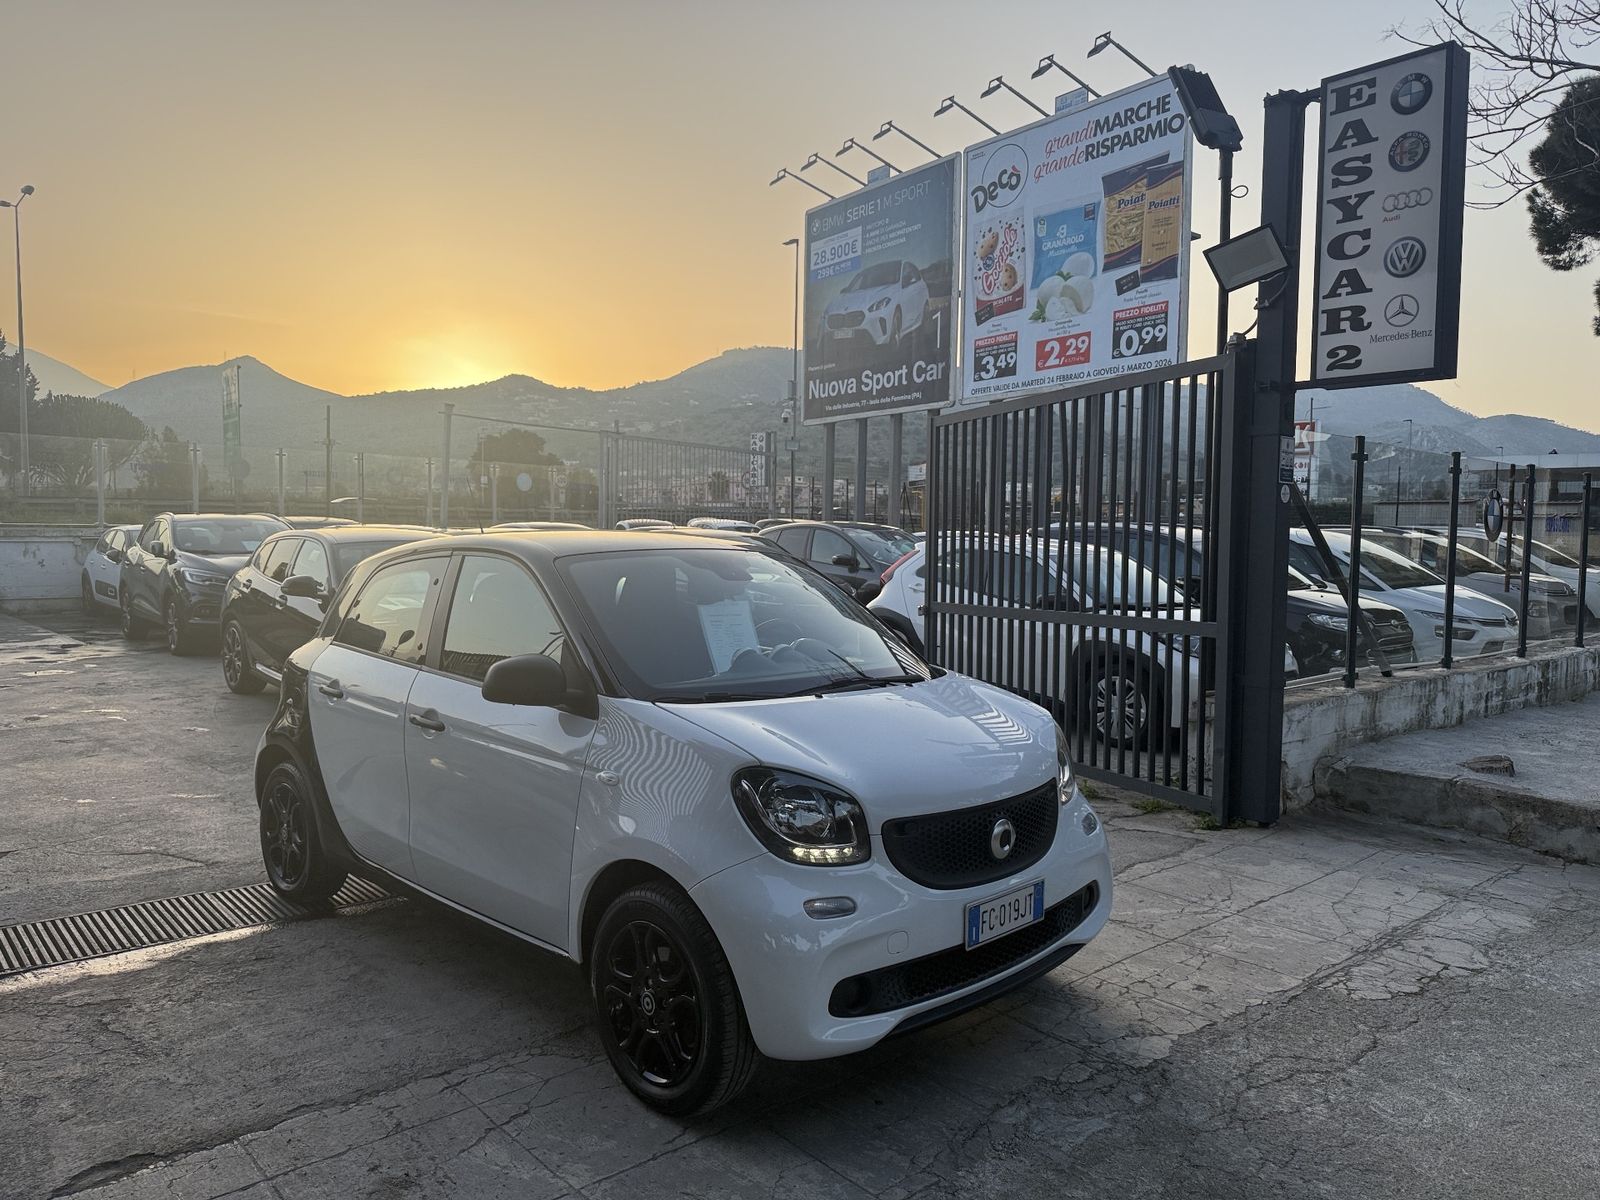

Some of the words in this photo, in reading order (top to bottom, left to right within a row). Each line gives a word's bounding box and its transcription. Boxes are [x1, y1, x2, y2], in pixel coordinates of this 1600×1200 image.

[822, 212, 845, 231] BMW
[847, 201, 874, 222] SERIE
[876, 198, 881, 215] 1
[883, 194, 892, 209] M
[894, 179, 931, 206] SPORT
[1148, 196, 1180, 210] Poiatti
[1382, 214, 1401, 223] Audi
[1042, 234, 1085, 251] GRANAROLO
[813, 240, 858, 266] 28.900€
[1115, 309, 1140, 319] PREZZO
[1141, 303, 1166, 314] FIDELITY
[1369, 328, 1433, 344] Mercedes-Benz
[809, 378, 857, 399] Nuova
[861, 367, 908, 395] Sport
[913, 360, 946, 383] Car
[970, 385, 992, 396] OFFERTE
[993, 383, 1010, 392] VALIDE
[1047, 376, 1054, 384] 24
[1056, 371, 1085, 383] FEBBRAIO
[1086, 370, 1091, 378] A
[1121, 365, 1125, 373] 5
[1127, 361, 1152, 371] MARZO
[1155, 359, 1173, 368] 2026
